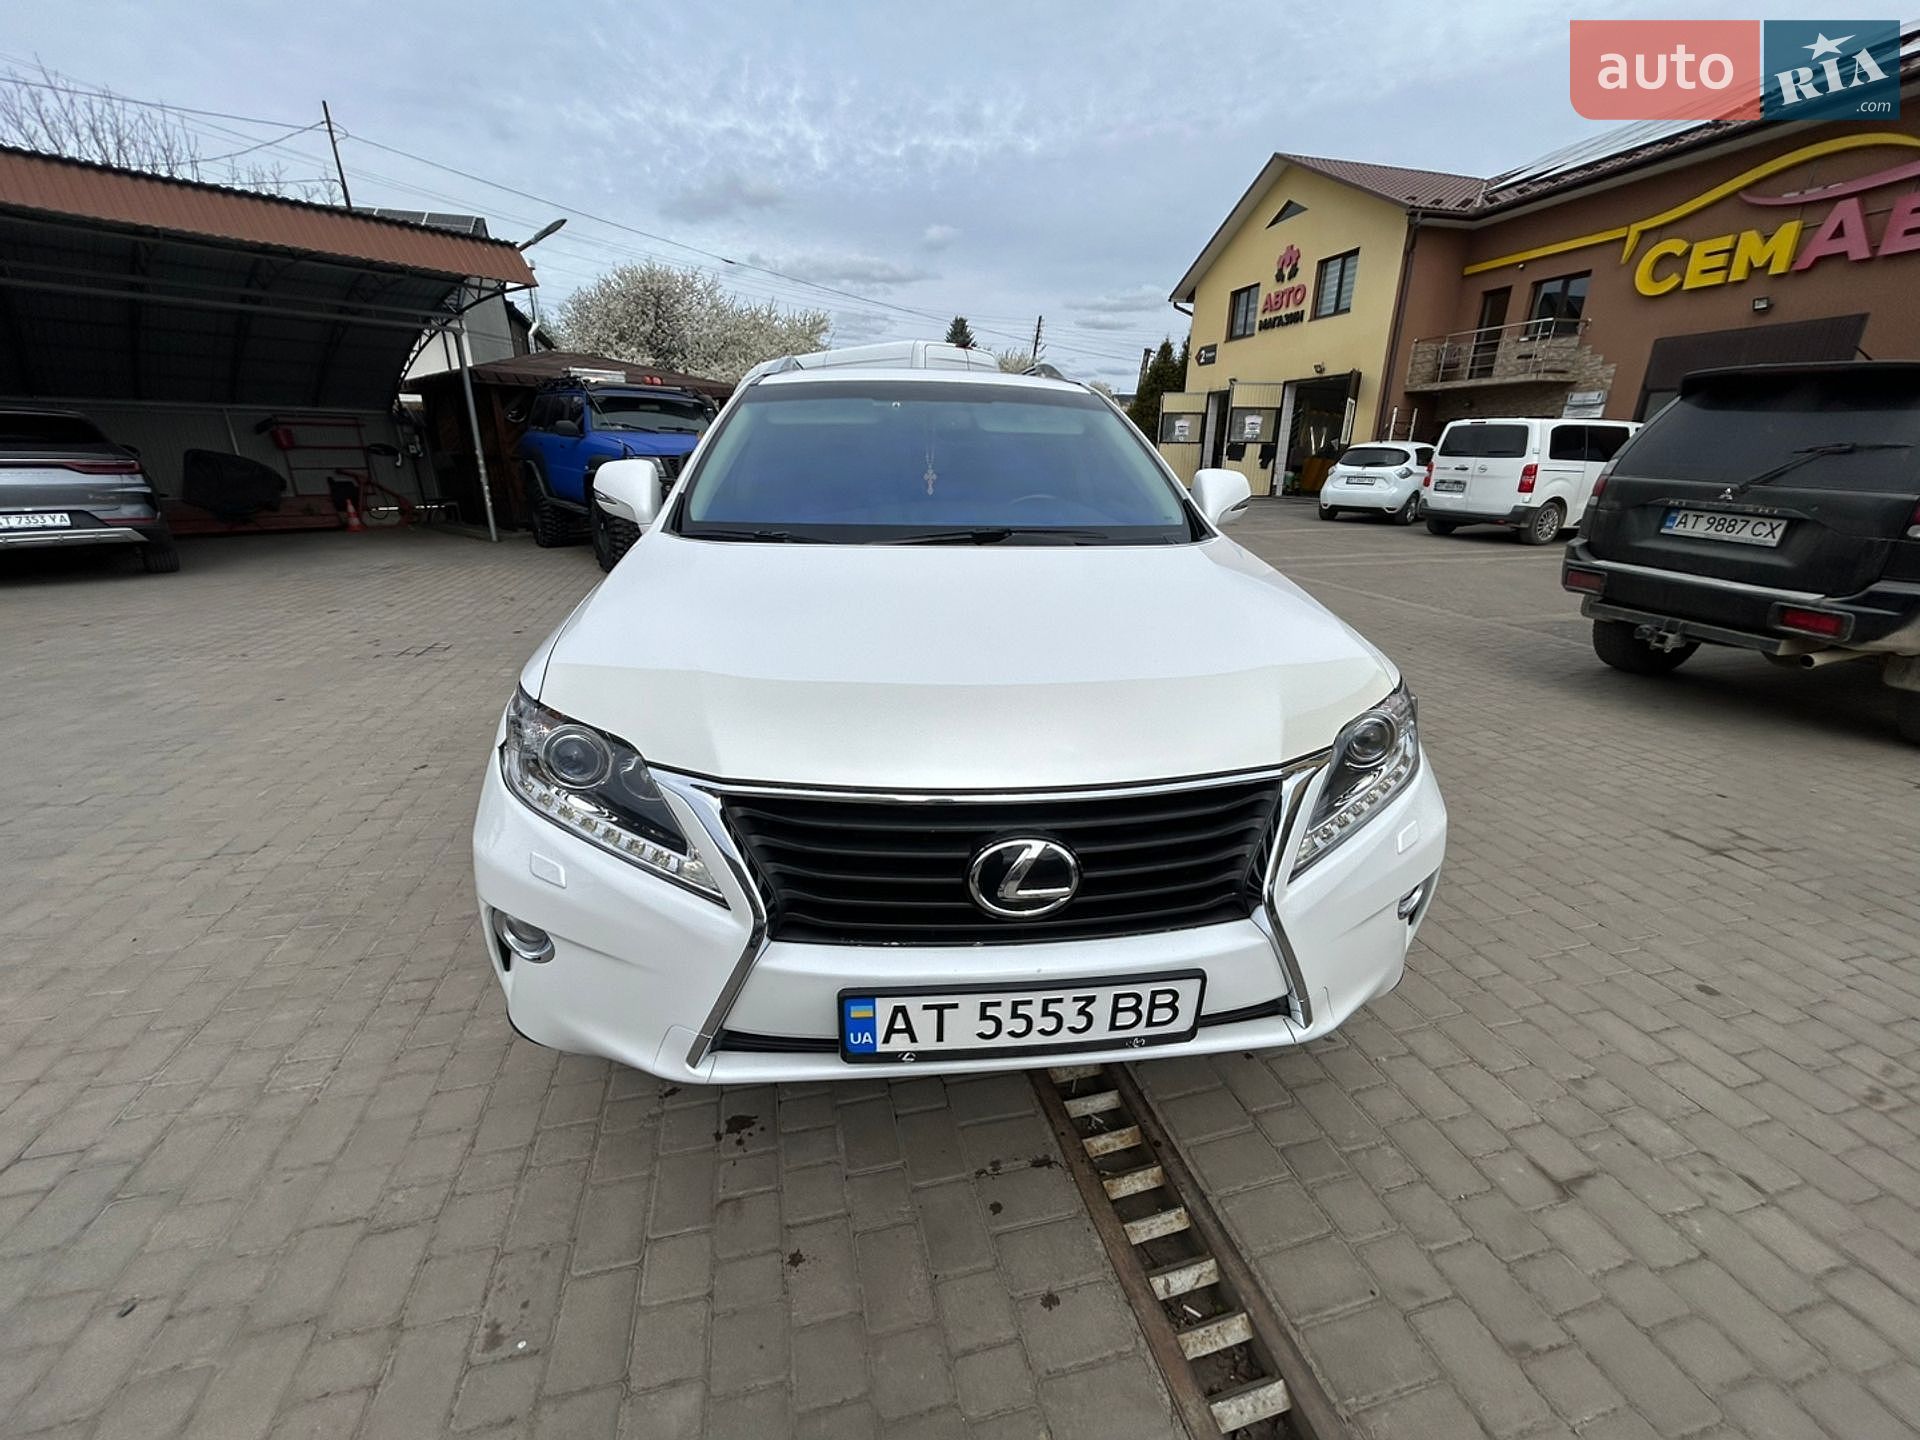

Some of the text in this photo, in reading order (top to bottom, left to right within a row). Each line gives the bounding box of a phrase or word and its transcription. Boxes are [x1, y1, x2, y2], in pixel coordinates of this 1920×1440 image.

[1261, 284, 1307, 314] АВТО
[1258, 310, 1305, 331] МАГАЗИН
[0, 516, 12, 525] T
[15, 515, 47, 524] 7353
[1674, 514, 1704, 529] AT
[1705, 516, 1751, 535] 9887
[1751, 521, 1782, 539] CX
[882, 988, 1180, 1044] AT 5553 BB
[850, 1032, 873, 1045] UA
